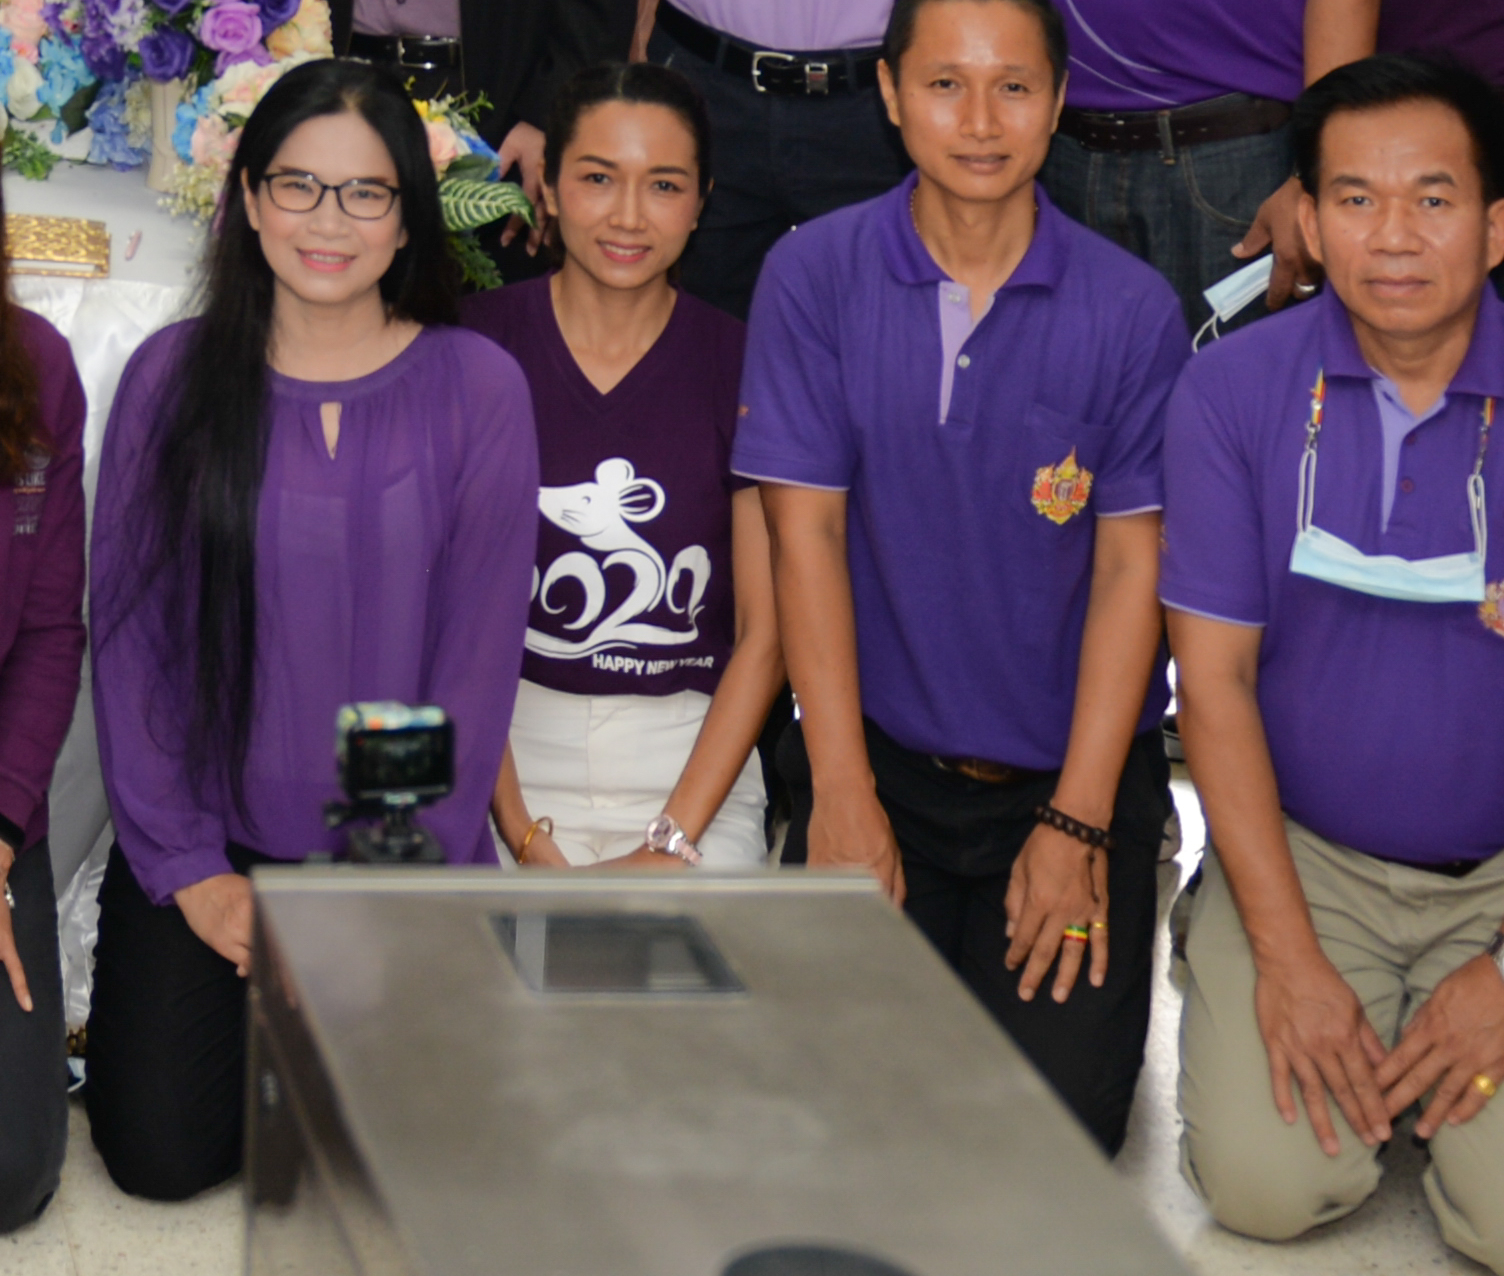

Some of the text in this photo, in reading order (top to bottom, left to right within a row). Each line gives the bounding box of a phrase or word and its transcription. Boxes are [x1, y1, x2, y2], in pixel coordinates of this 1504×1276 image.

[525, 545, 711, 659] 020
[592, 653, 715, 676] HAPPY NEW YEAR
